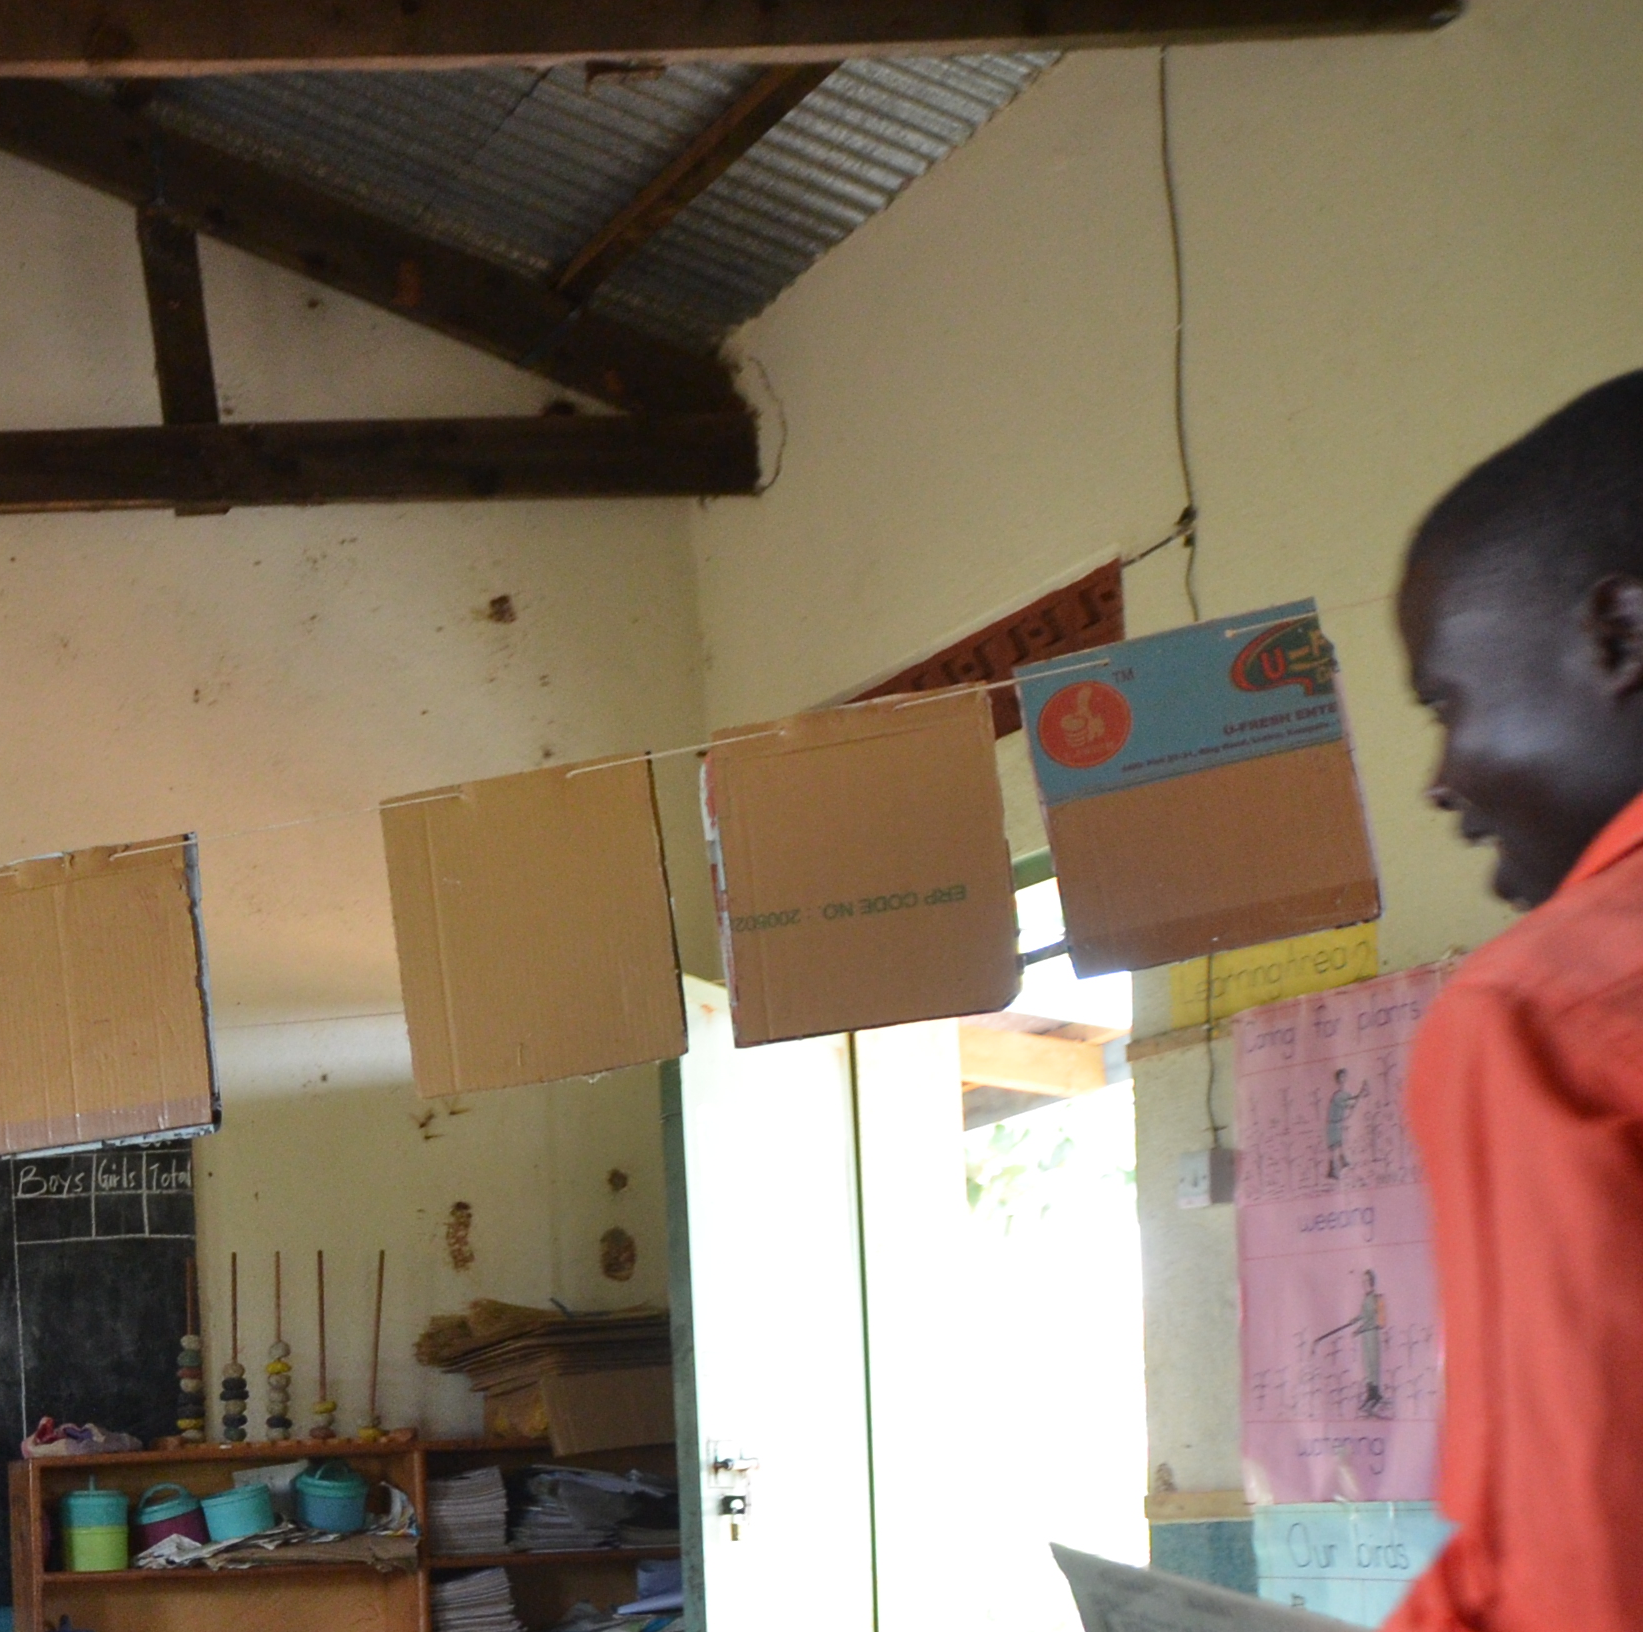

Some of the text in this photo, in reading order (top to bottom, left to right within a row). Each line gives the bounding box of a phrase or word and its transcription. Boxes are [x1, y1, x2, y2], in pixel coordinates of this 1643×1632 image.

[857, 891, 919, 915] CODE
[925, 884, 967, 904] ERP
[18, 1156, 192, 1198] Boys Girls Total
[1286, 1518, 1411, 1571] Our birds
